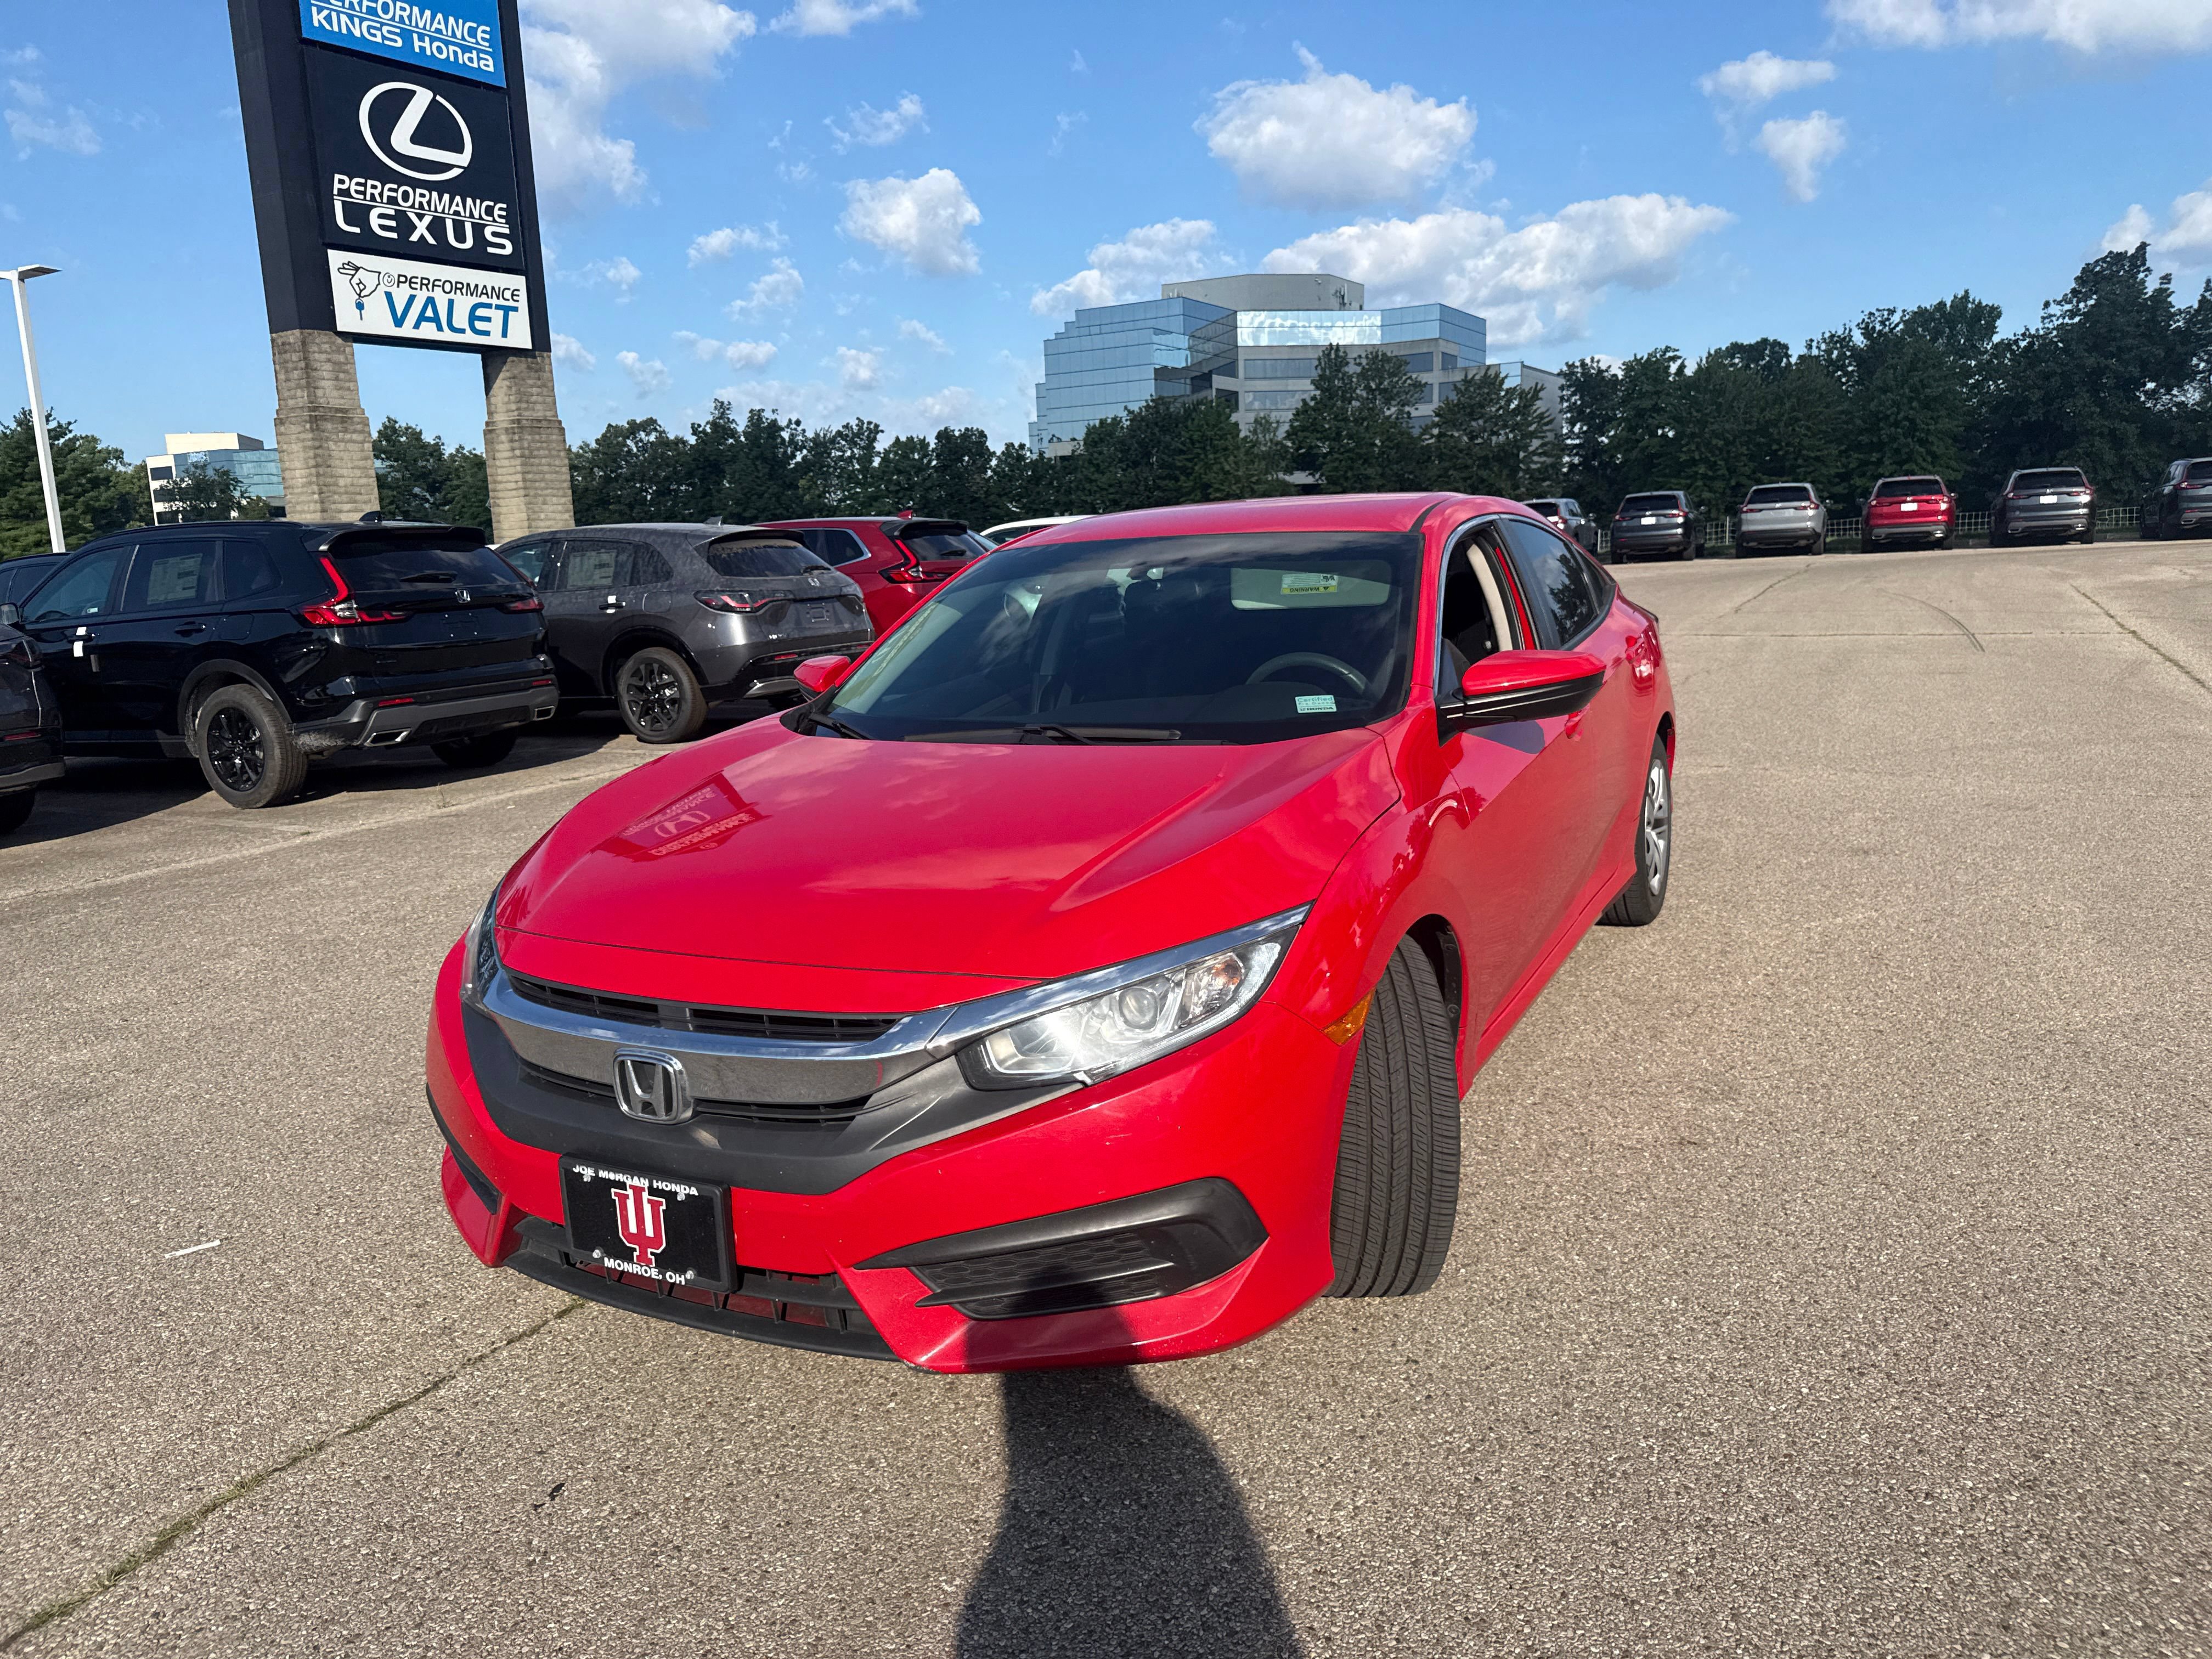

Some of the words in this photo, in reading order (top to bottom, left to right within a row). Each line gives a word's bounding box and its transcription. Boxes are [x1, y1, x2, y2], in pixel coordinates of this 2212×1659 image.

[311, 5, 403, 48] KINGS
[413, 33, 494, 72] Honda
[330, 0, 490, 46] RFORMANCE
[333, 173, 507, 223] PERFORMANCE
[334, 199, 513, 255] LEXUS
[397, 274, 520, 302] PERFORMANCE
[384, 291, 519, 338] VALET
[573, 1165, 596, 1177] JOE
[598, 1169, 650, 1187] MORGAN
[653, 1180, 699, 1196] HONDA
[604, 1257, 662, 1280] MONROE,
[665, 1271, 686, 1285] OH
